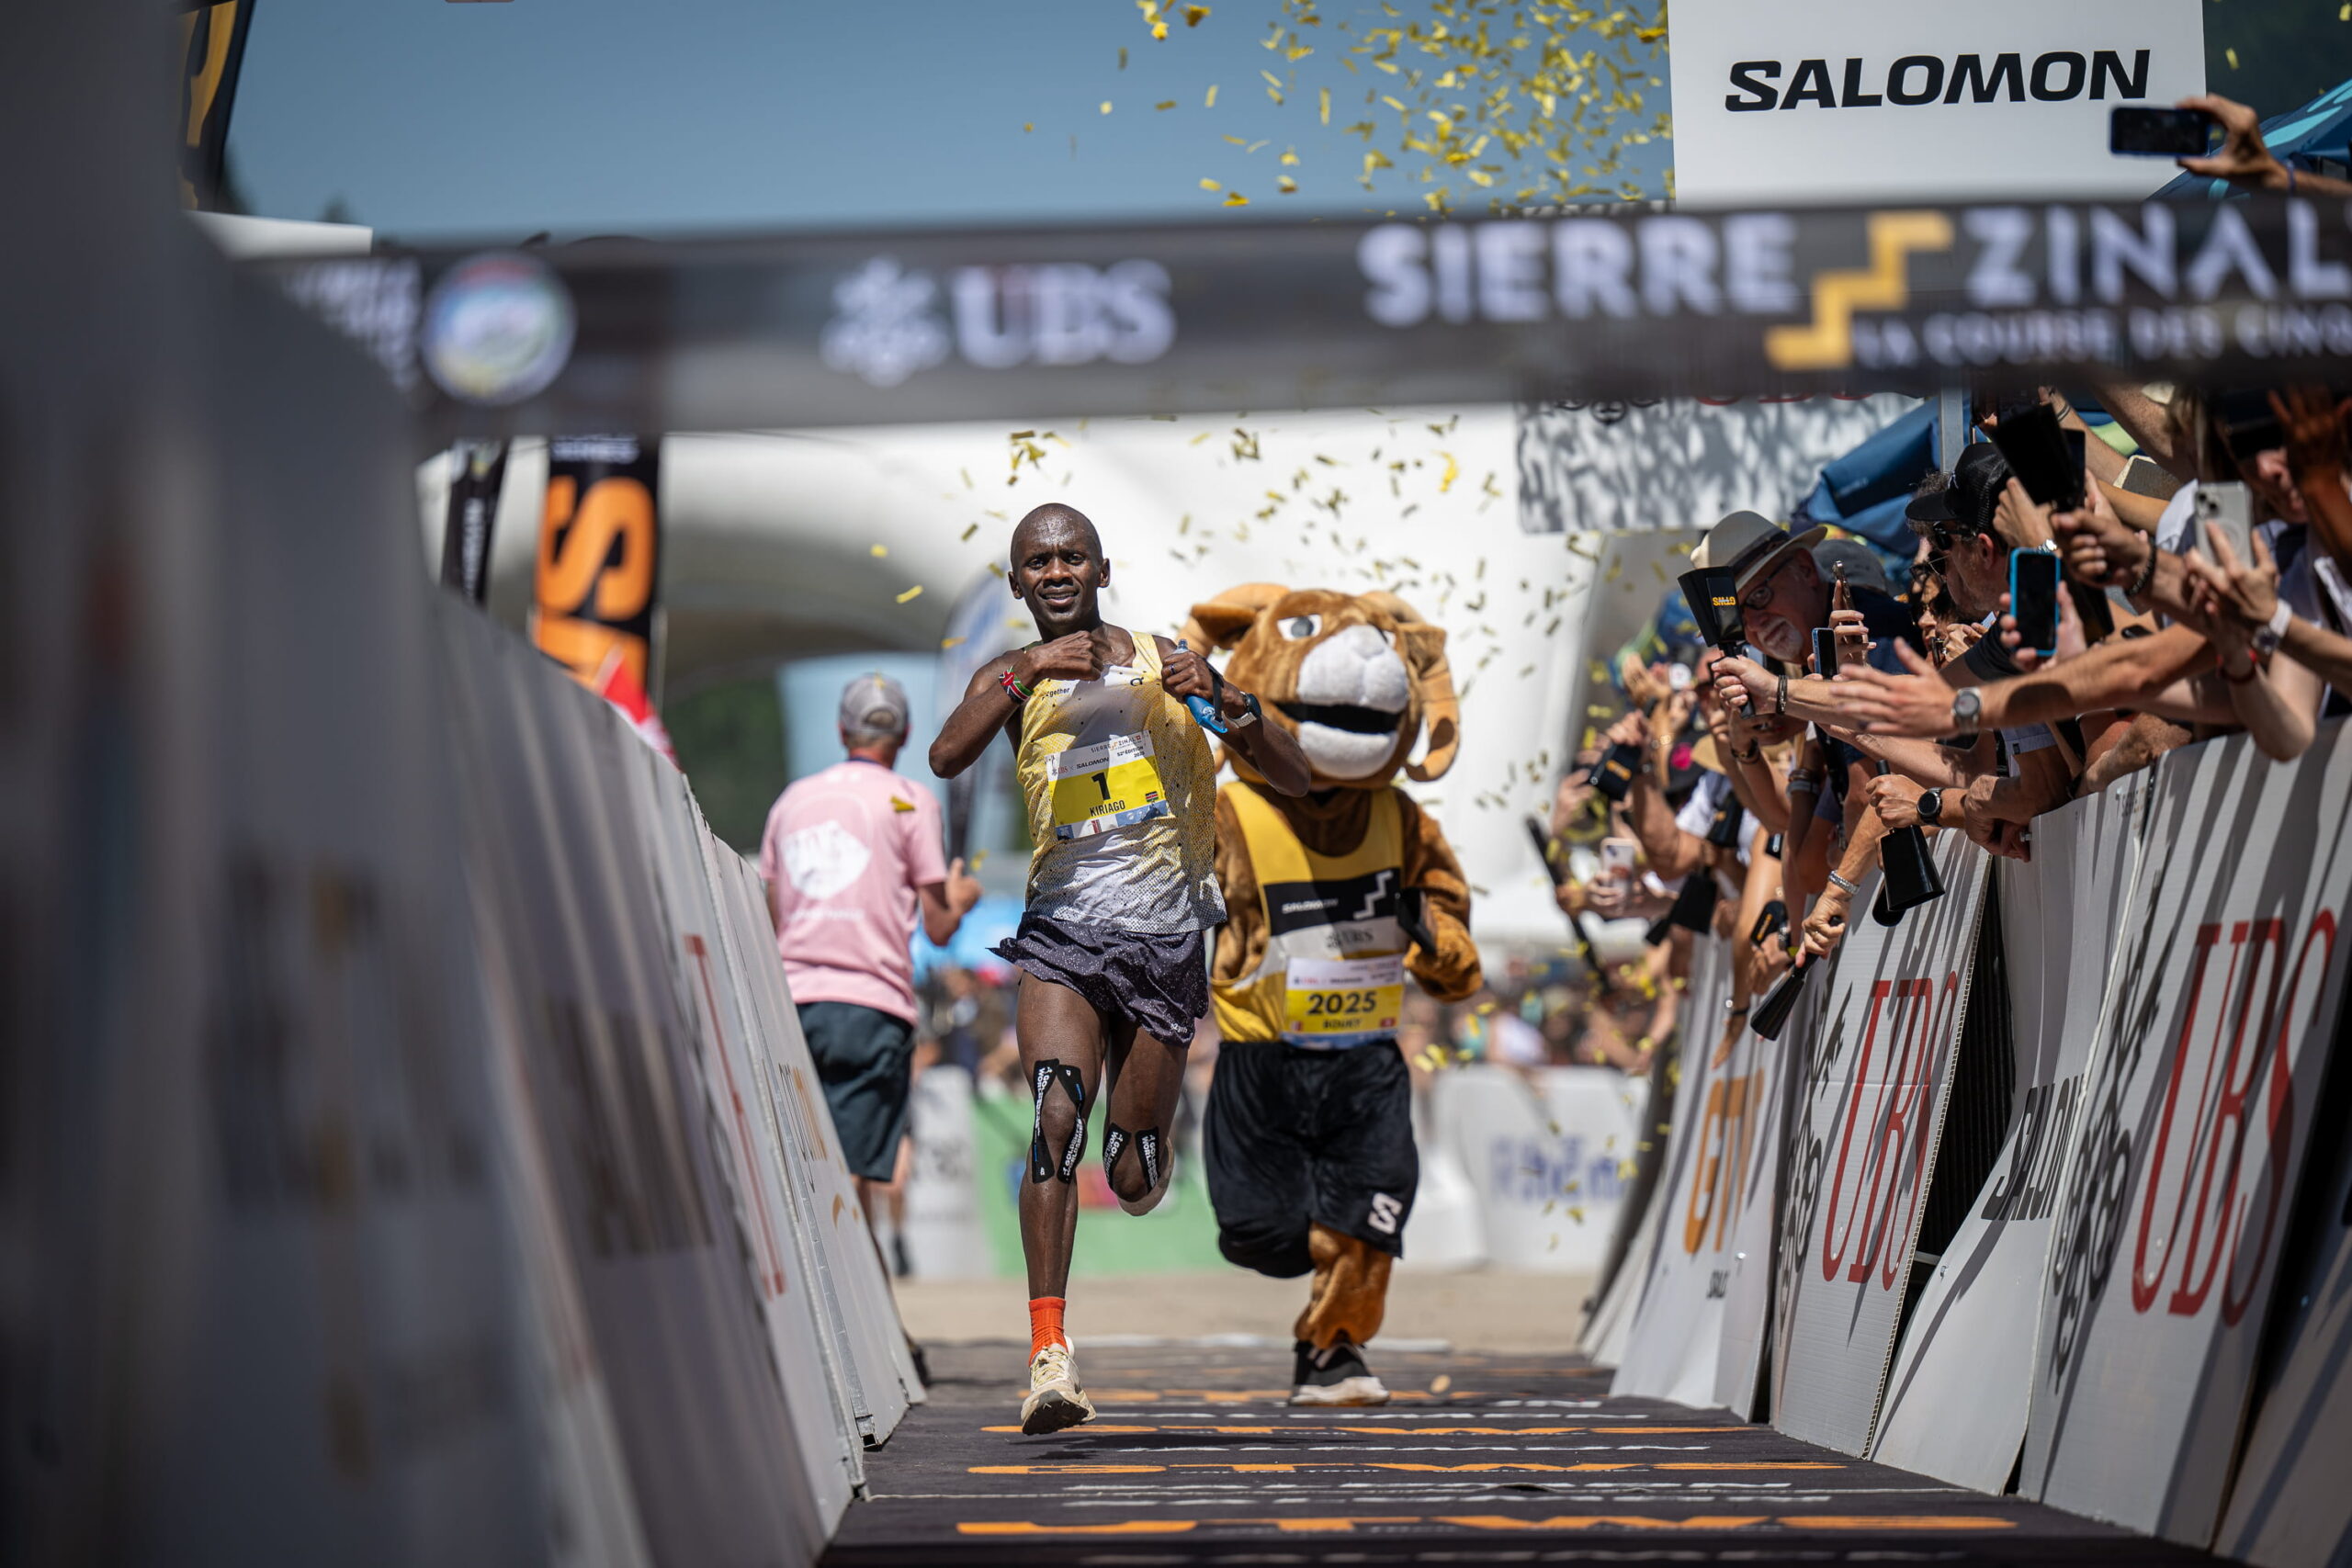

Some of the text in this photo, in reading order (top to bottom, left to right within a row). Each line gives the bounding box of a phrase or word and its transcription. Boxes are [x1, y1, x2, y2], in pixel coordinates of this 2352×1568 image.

[1724, 49, 2151, 112] SALOMON
[1358, 200, 2352, 327] SIERRE ZINAL
[952, 261, 1176, 367] UBS
[1076, 757, 1110, 770] SALOMON
[1091, 772, 1111, 801] 1
[1089, 799, 1125, 818] KIRIAGO
[1307, 991, 1377, 1016] 2025
[1823, 971, 1958, 1292] UBS
[2131, 908, 2336, 1327] UBS
